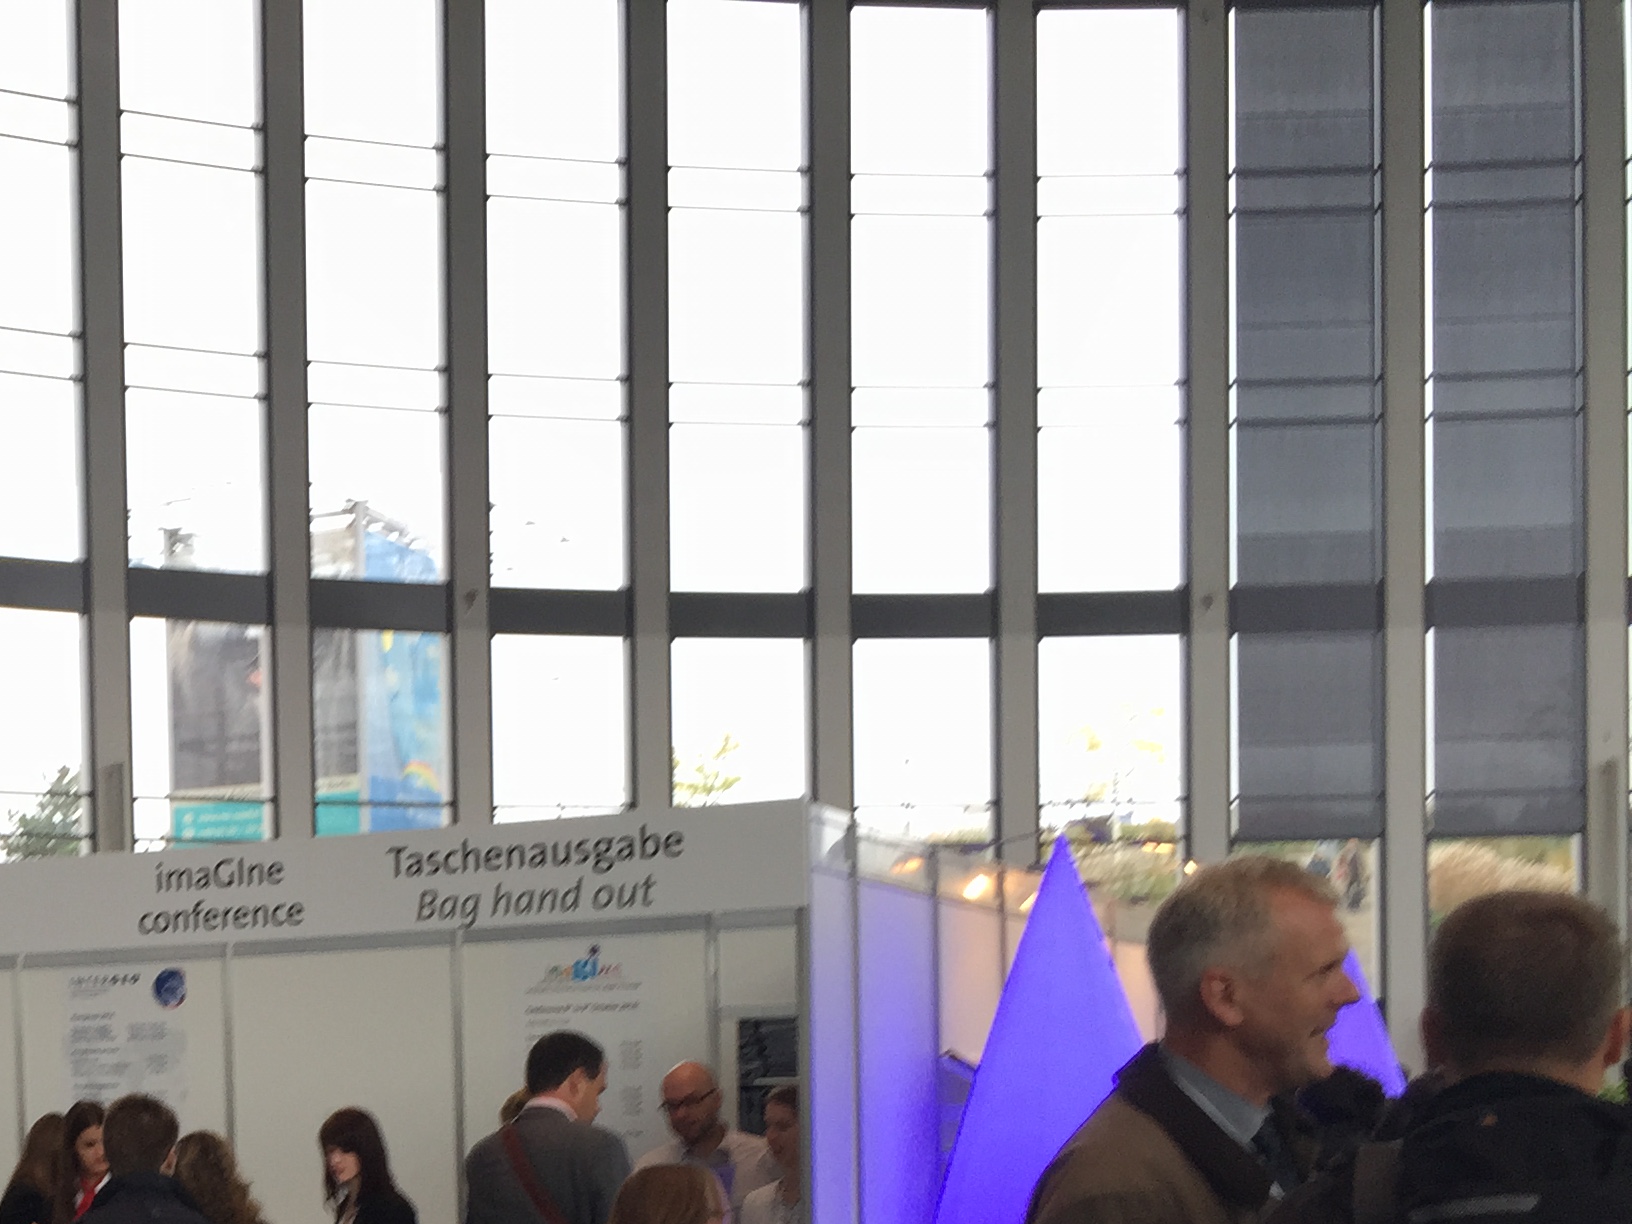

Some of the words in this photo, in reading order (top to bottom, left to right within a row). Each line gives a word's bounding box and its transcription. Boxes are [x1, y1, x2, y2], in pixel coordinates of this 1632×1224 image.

[386, 823, 685, 875] Taschenausgabe
[155, 856, 285, 893] imaGIne
[137, 899, 305, 936] conference
[416, 888, 481, 929] Bag
[490, 876, 584, 918] hand
[591, 873, 657, 912] out
